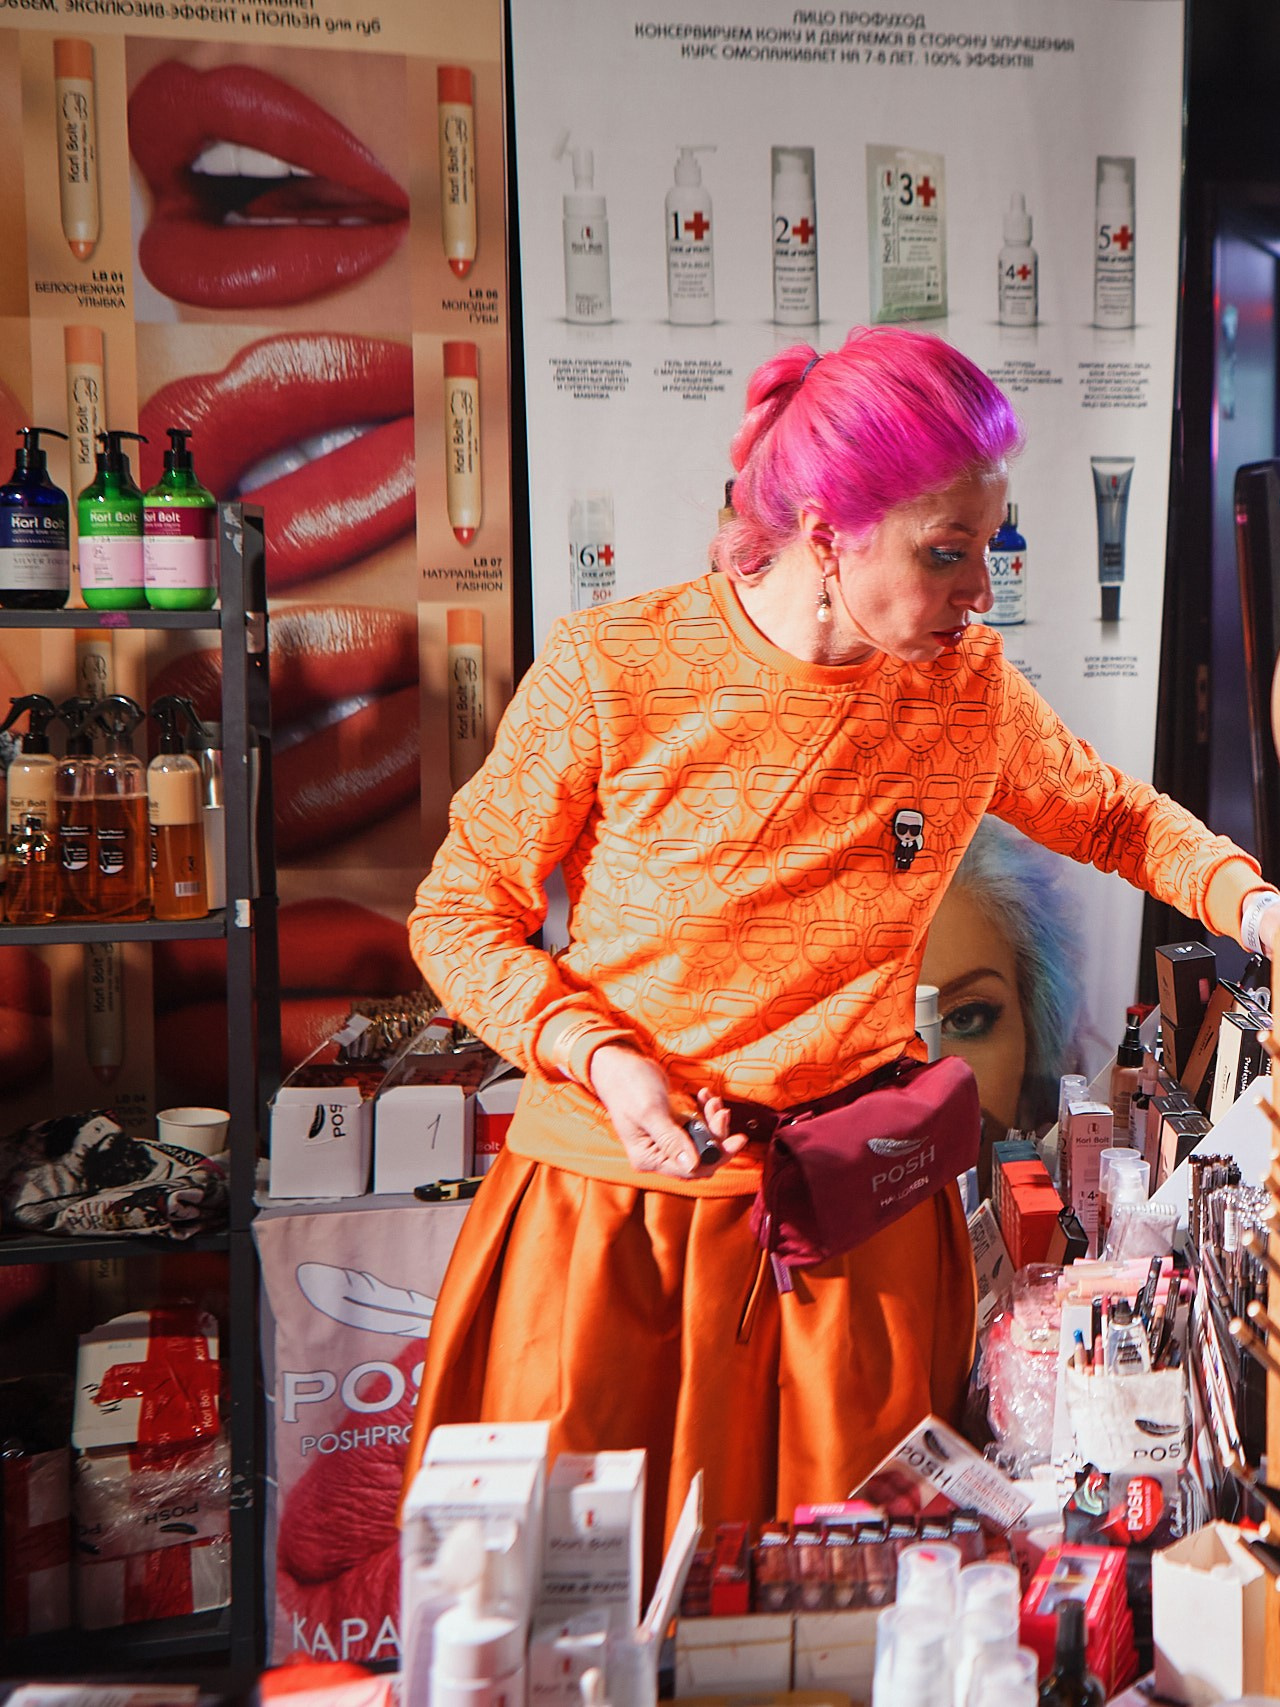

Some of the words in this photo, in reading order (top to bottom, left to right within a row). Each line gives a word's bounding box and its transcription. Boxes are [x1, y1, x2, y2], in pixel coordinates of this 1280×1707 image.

[256, 10, 320, 29] ПОЛЬЗА
[793, 9, 836, 26] ЛИЦО
[841, 11, 926, 30] ПРОФУХОД
[635, 22, 752, 41] КОНСЕРВИРУЕМ
[756, 27, 801, 43] КОЖУ
[805, 29, 816, 43] И
[820, 30, 903, 47] ДВИГАЕМСЯ
[908, 32, 916, 46] В
[920, 33, 987, 49] СТОРОНУ
[991, 35, 1075, 52] УЛУЧШЕНИЯ
[681, 43, 718, 60] КУРС
[722, 44, 836, 62] ОМОЛАЖИВАЕТ
[841, 50, 859, 64] НА
[925, 51, 960, 67] 100%
[899, 173, 913, 206] 3
[775, 216, 791, 243] 2
[1098, 225, 1112, 250] 5
[1005, 264, 1016, 280] 4
[35, 281, 124, 296] БЕЛОСНЕЖНАЯ
[78, 296, 126, 308] УЛЫБКА
[442, 300, 498, 312] МОЛОДЫЕ
[469, 313, 499, 324] ГУБЫ
[11, 515, 38, 529] Karl
[43, 516, 65, 530] Bolt
[90, 512, 111, 522] Karl
[115, 511, 138, 523] Bolt
[158, 511, 180, 523] Bolt
[474, 558, 487, 568] LB
[580, 544, 595, 567] 6
[423, 567, 502, 579] НАТУРАЛЬНЫЙ
[456, 581, 503, 591] FASHION
[1094, 1136, 1109, 1144] Bolt
[872, 1144, 936, 1193] POSH
[1134, 1438, 1186, 1462] POS
[896, 1445, 953, 1488] POSH
[145, 1502, 199, 1525] POSH
[1128, 1479, 1143, 1531] POSH
